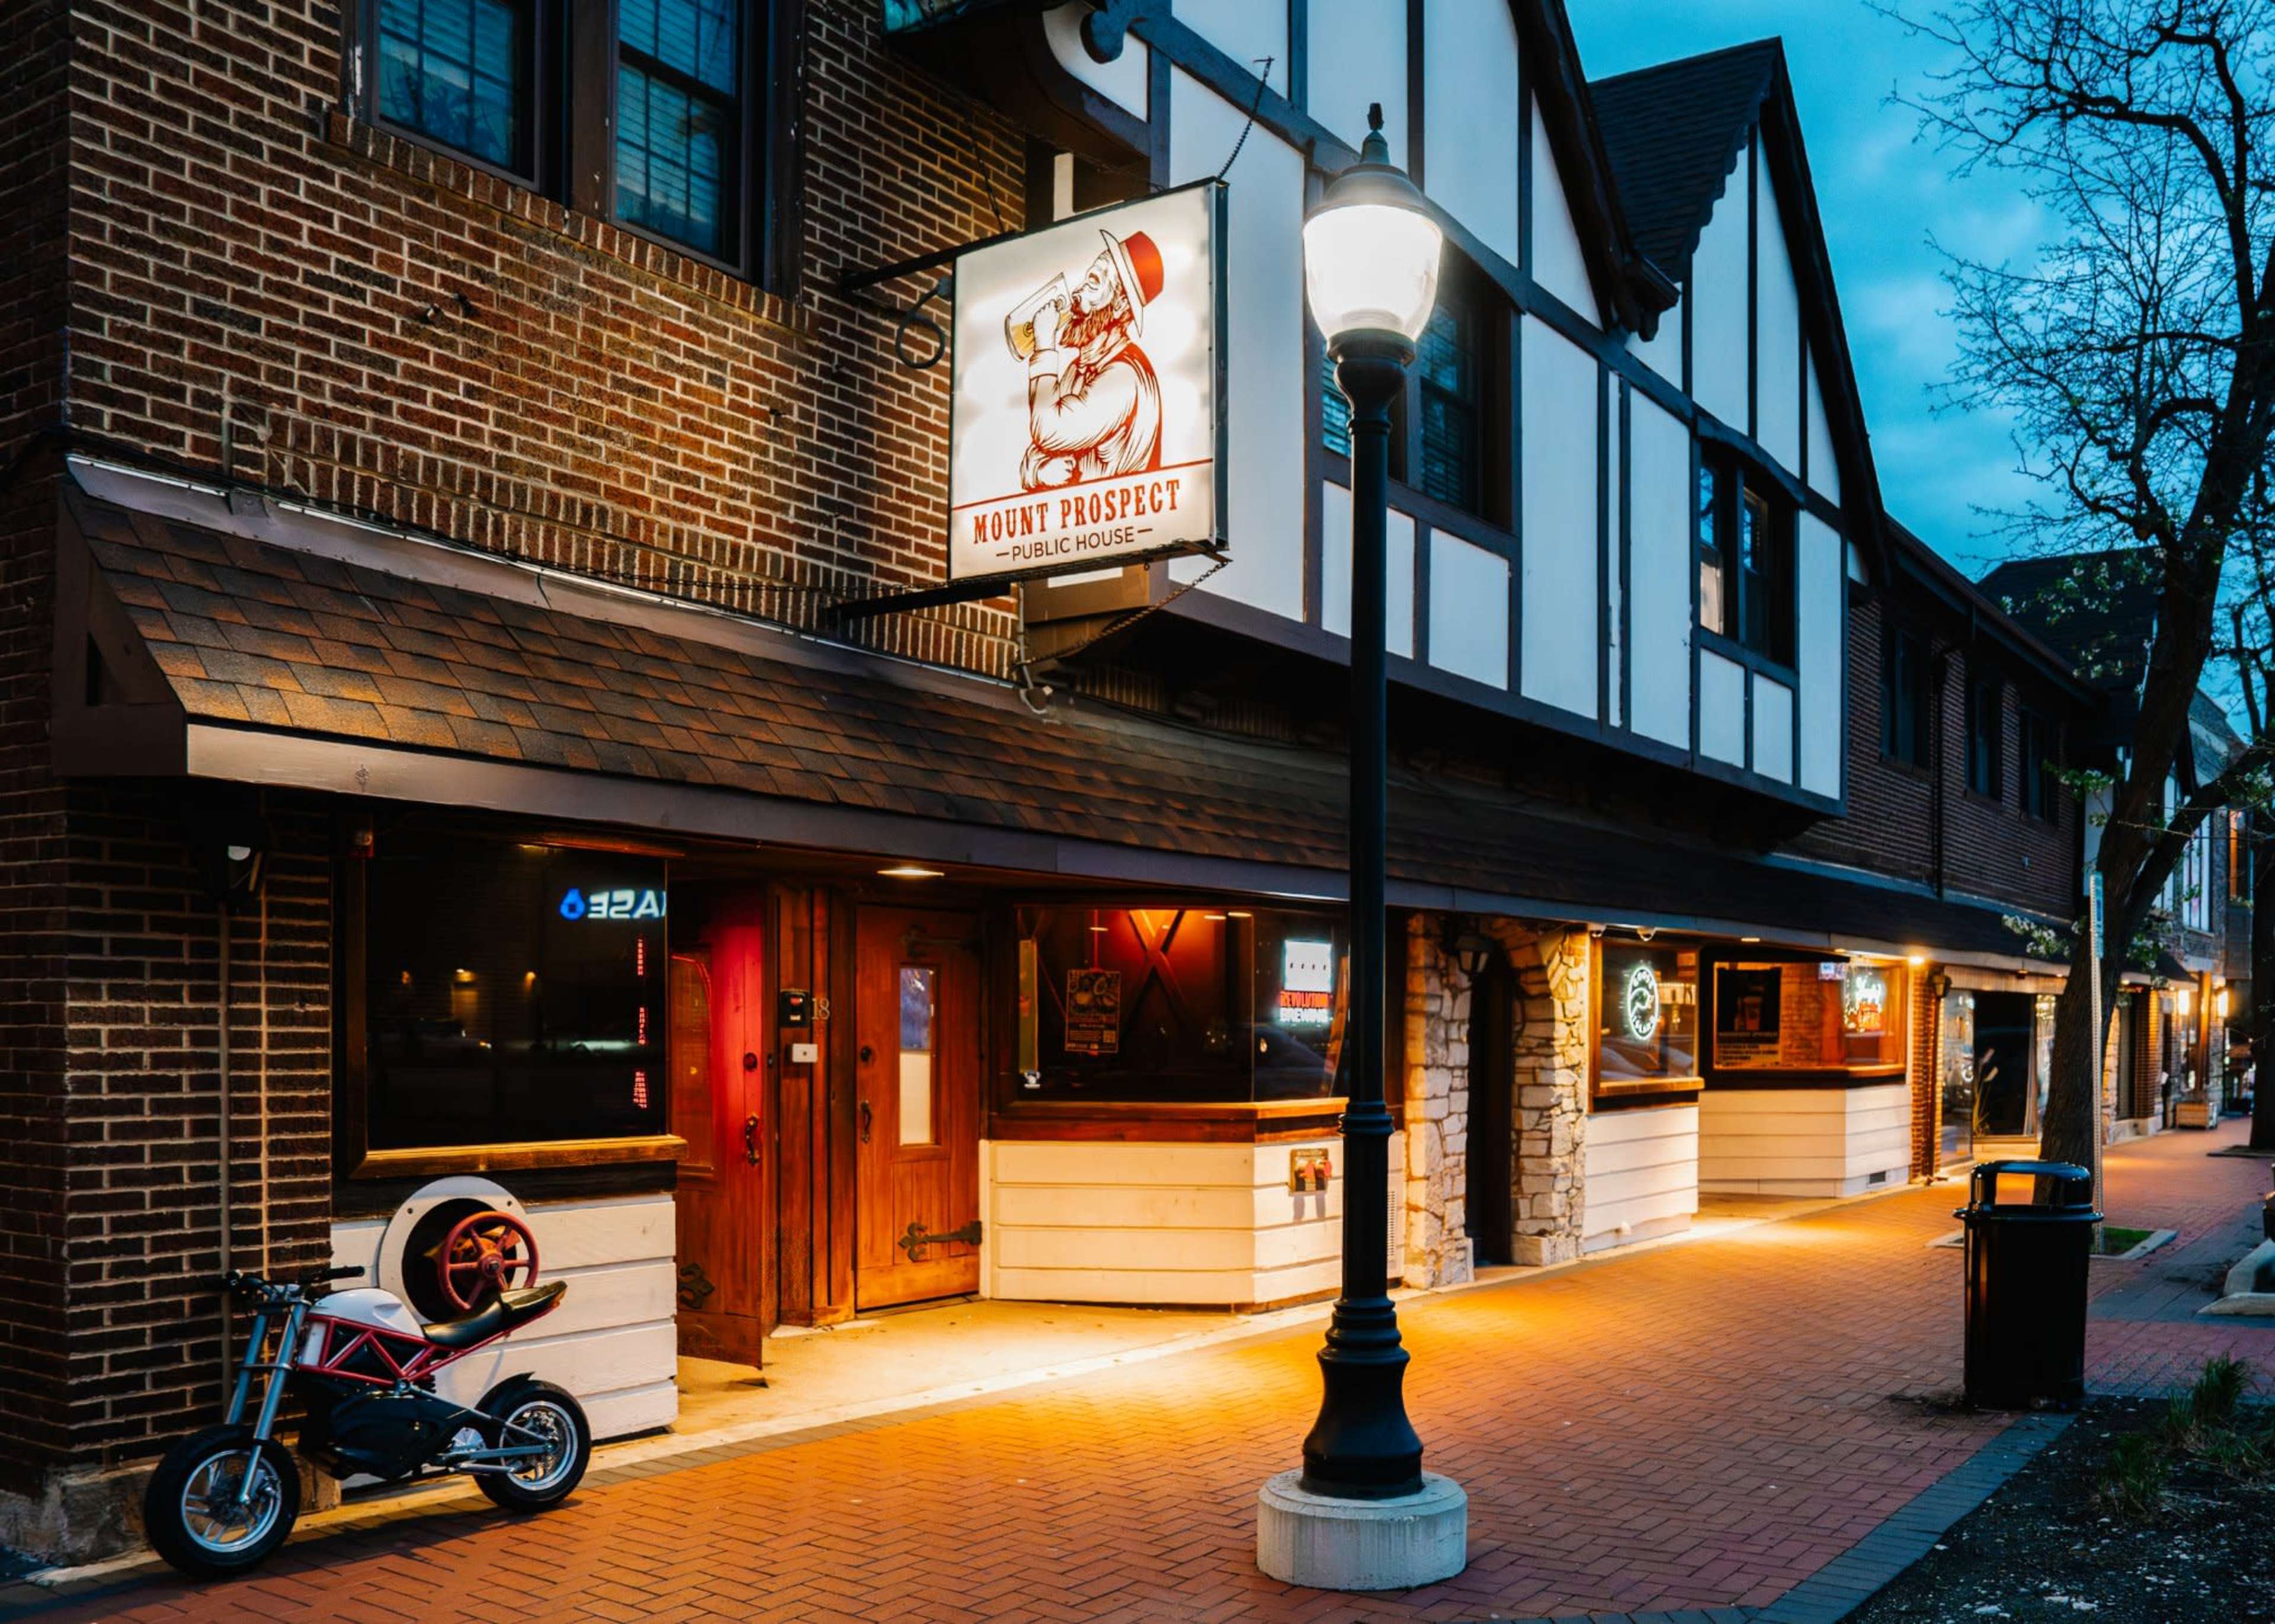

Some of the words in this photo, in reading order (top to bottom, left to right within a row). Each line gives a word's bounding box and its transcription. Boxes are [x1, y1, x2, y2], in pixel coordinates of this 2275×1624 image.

[973, 502, 1049, 544] MOUNT
[1060, 479, 1180, 528] PROSPECT
[1012, 536, 1071, 561] PUBLIC
[1076, 526, 1135, 551] HOUSE
[811, 997, 831, 1020] 18
